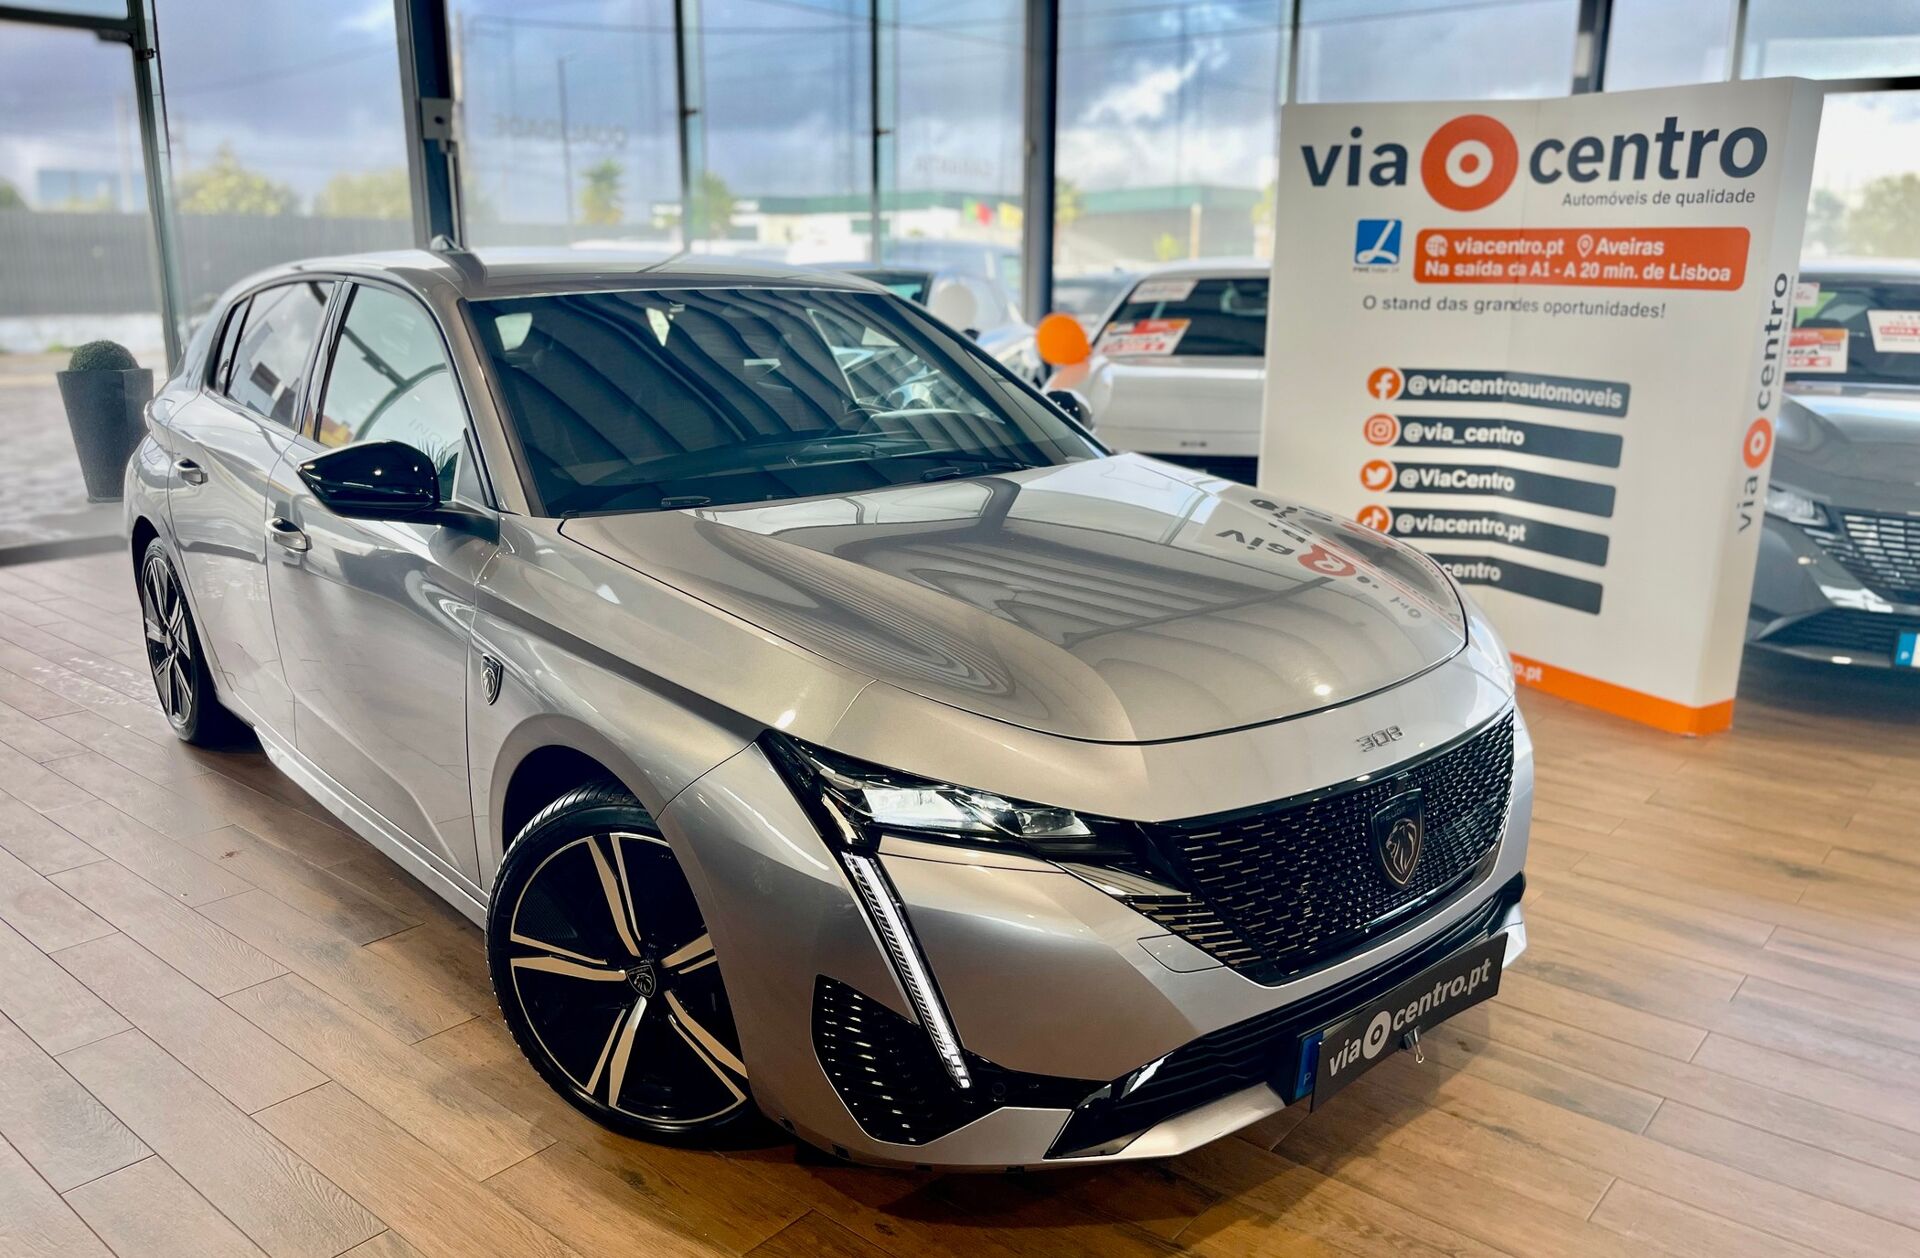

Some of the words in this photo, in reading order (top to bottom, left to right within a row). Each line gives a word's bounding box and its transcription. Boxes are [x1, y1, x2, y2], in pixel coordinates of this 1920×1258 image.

[1301, 126, 1408, 187] via
[1529, 116, 1768, 185] centro
[1562, 191, 1647, 207] Automóveis
[1652, 190, 1671, 205] de
[1675, 189, 1756, 208] qualidade
[1454, 237, 1564, 258] viacentro.pt
[1595, 237, 1664, 256] Aveiras
[1425, 260, 1449, 277] Na
[1454, 260, 1503, 277] saída
[1530, 261, 1550, 278] A1
[1563, 261, 1577, 278] A
[1580, 262, 1599, 279] 20
[1603, 262, 1639, 280] min.
[1642, 263, 1665, 280] de
[1669, 263, 1731, 282] Lisboa
[1362, 294, 1377, 310] O
[1382, 297, 1431, 311] stand
[1437, 296, 1468, 311] das
[1474, 298, 1539, 315] grandes
[1543, 299, 1666, 319] oportunidades!
[1757, 273, 1788, 411] centro
[1407, 374, 1622, 410] @viacentroautomoveis
[1403, 422, 1525, 446] @via_centro
[1399, 468, 1516, 492] @ViaCentro
[1736, 476, 1758, 534] via
[1396, 513, 1527, 542] @viacentro.pt
[1442, 561, 1502, 582] centro
[1356, 724, 1404, 752] 308
[1329, 1037, 1361, 1077] via
[1392, 957, 1492, 1032] centro.pt
[1303, 1072, 1312, 1087] P
